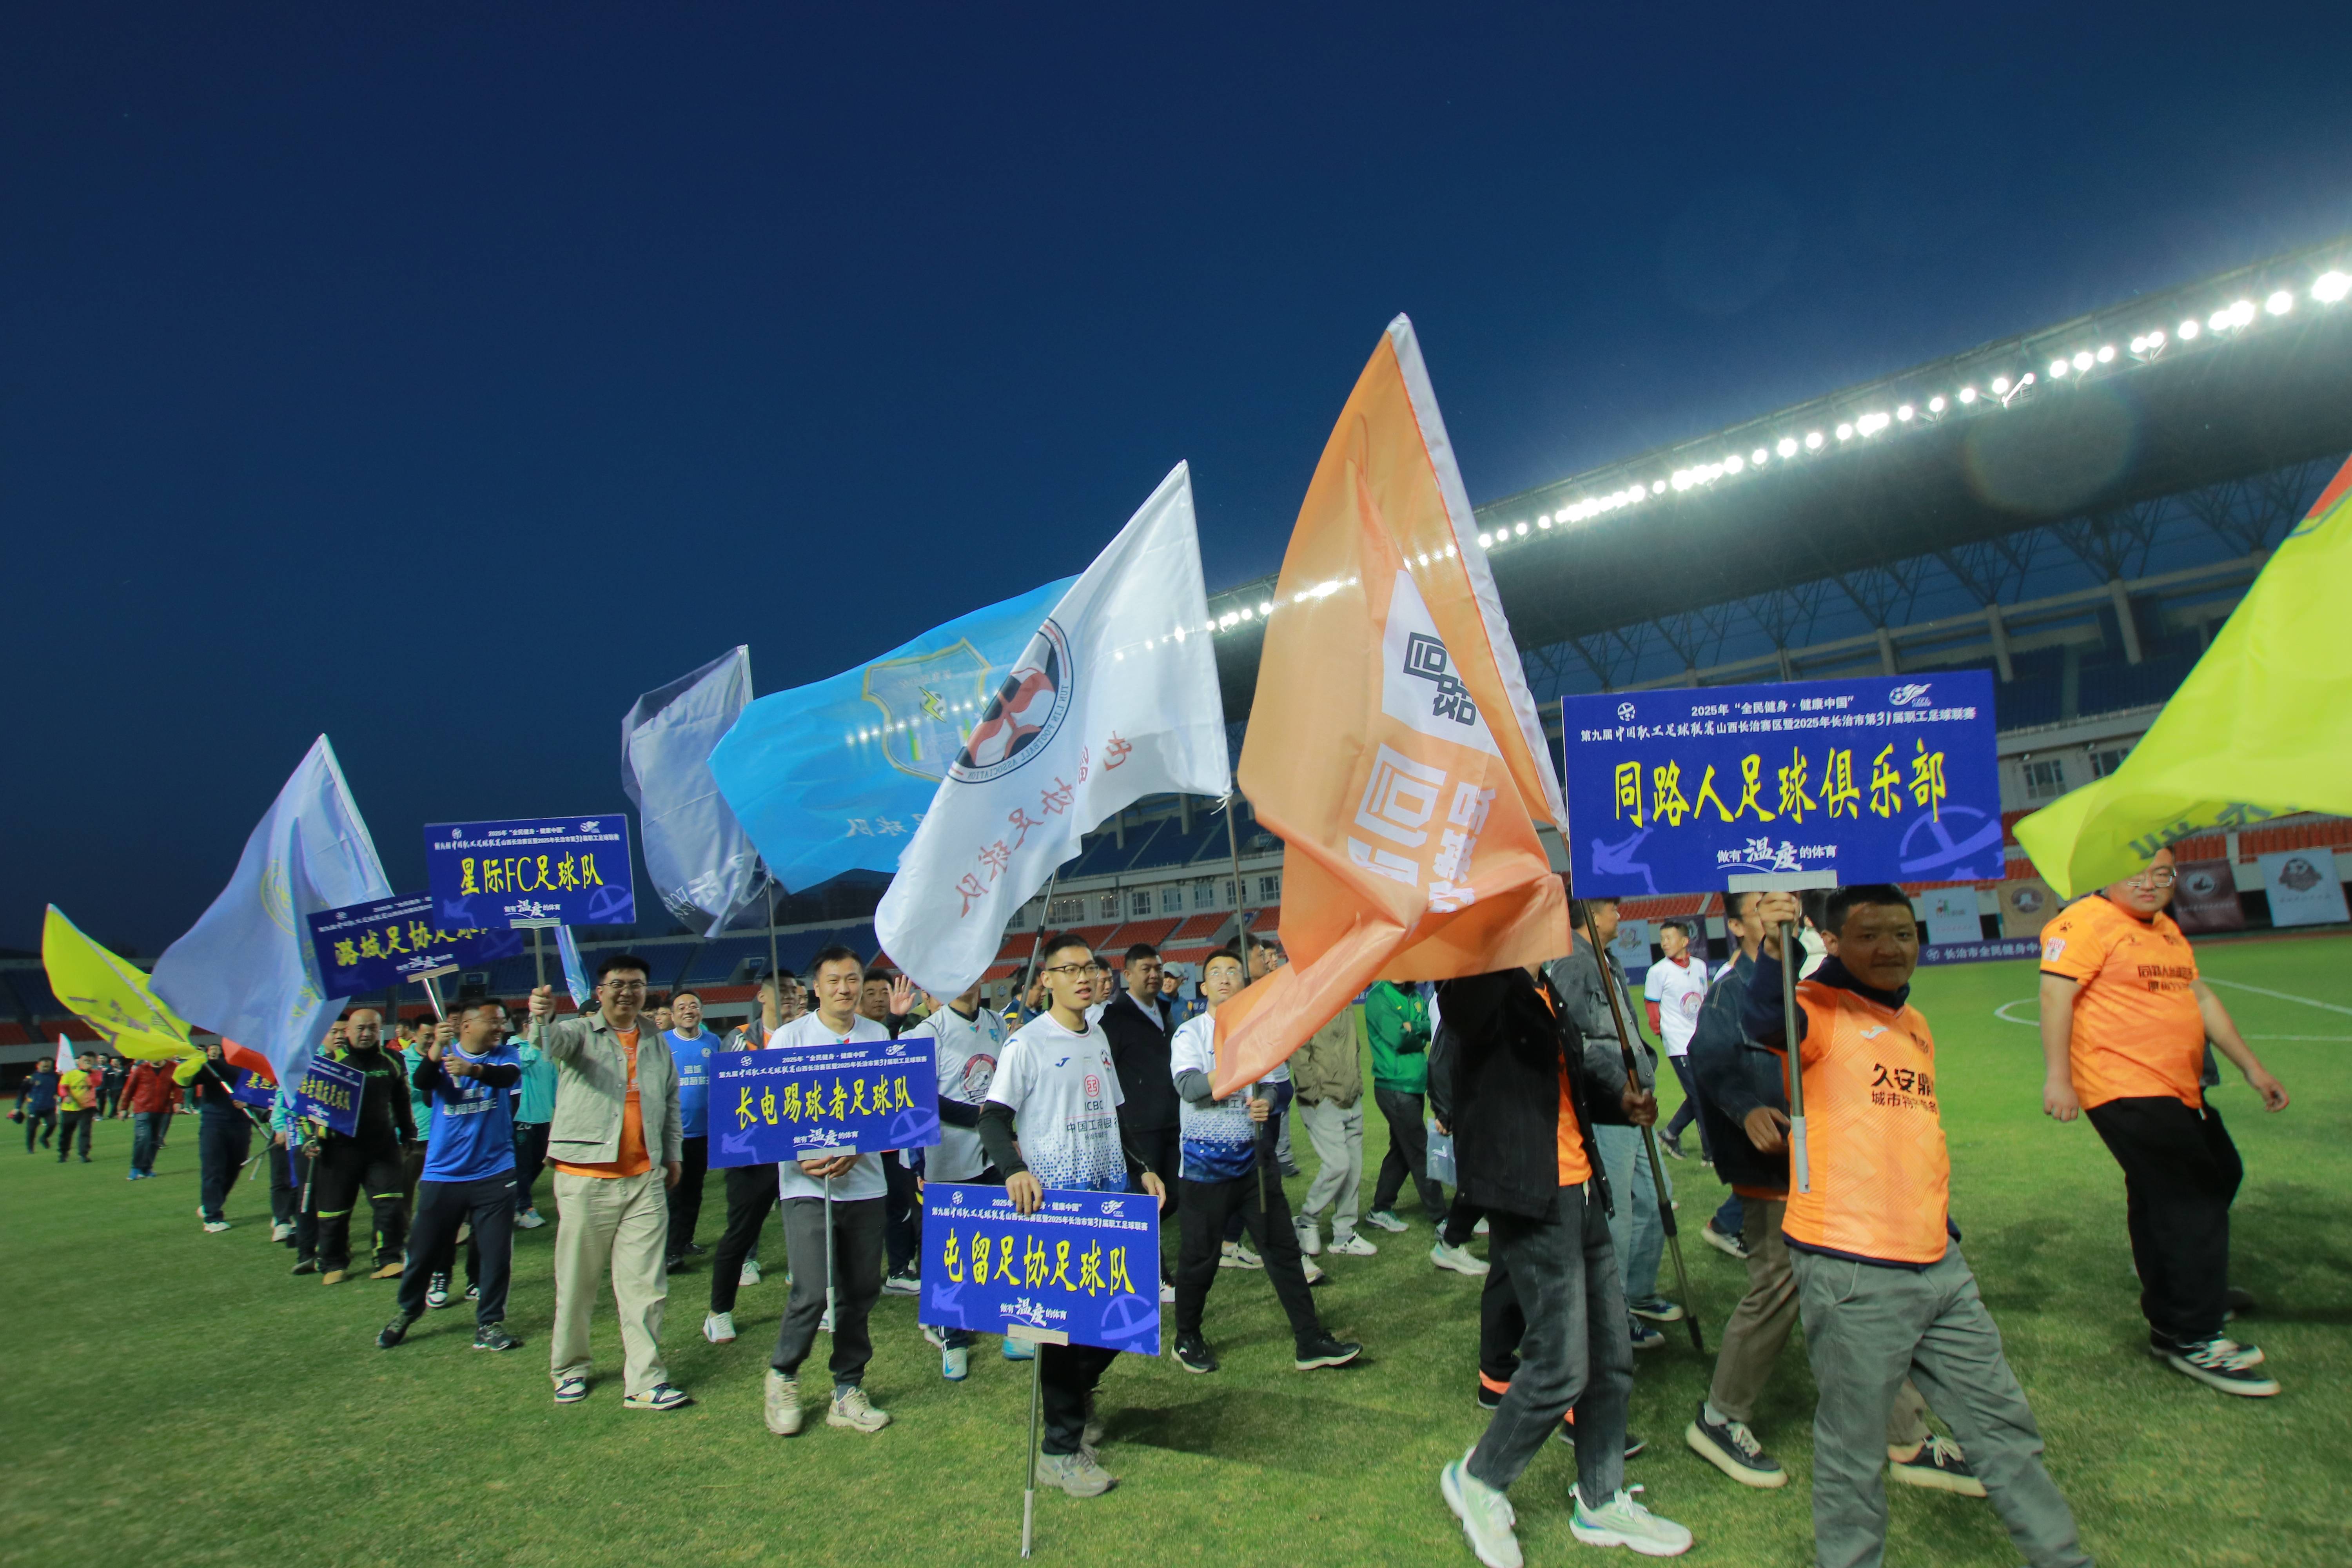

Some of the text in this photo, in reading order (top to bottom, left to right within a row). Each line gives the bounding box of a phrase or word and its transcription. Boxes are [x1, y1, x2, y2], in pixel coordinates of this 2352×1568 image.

[1615, 739, 1946, 828] 同路人足球俱乐部
[460, 851, 604, 896] 星际FC足球队
[1717, 836, 1837, 871] 做有温度的体育
[334, 920, 488, 966] 潞城足协
[1944, 942, 2041, 961] 长治市全民健身中
[735, 1074, 915, 1130] 长电踢球者足球队
[1084, 1100, 1103, 1111] ICBC
[943, 1227, 1136, 1297] 屯留足协足球队
